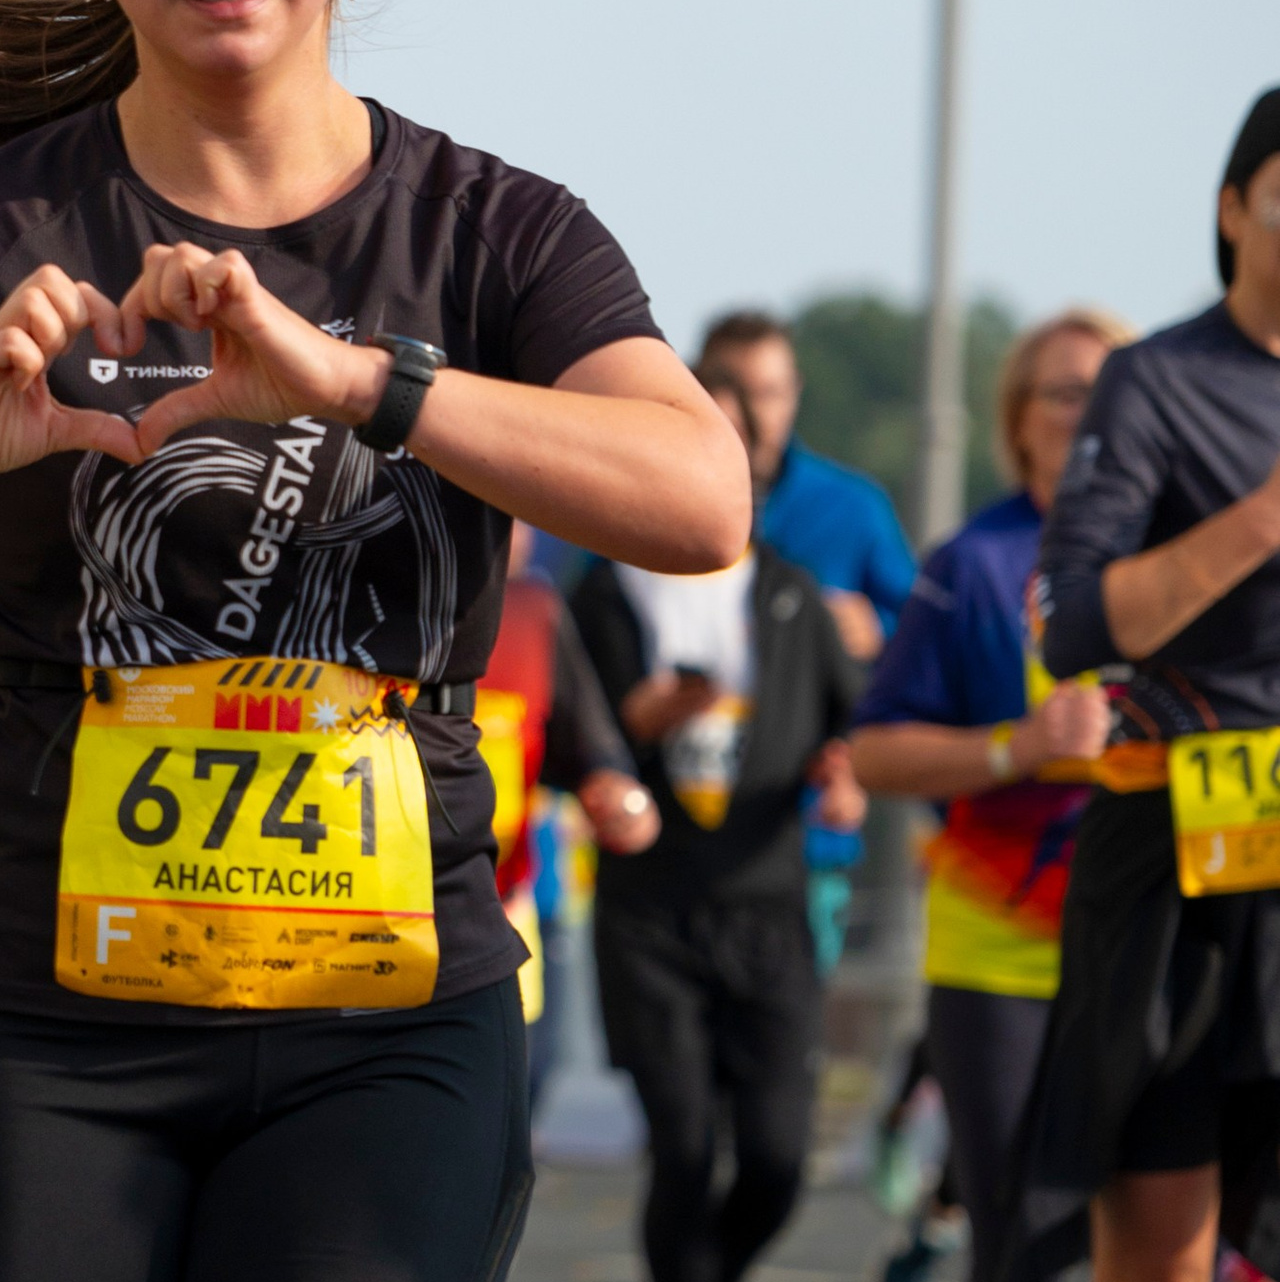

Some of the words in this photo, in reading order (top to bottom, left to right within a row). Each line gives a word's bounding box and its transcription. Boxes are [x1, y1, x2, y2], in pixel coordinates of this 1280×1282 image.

[123, 365, 214, 379] ТИНЬКО
[118, 747, 377, 856] 6741
[153, 863, 353, 898] АНАСТАСИЯ
[96, 905, 137, 965] F
[101, 974, 164, 988] ФУТБОЛКА
